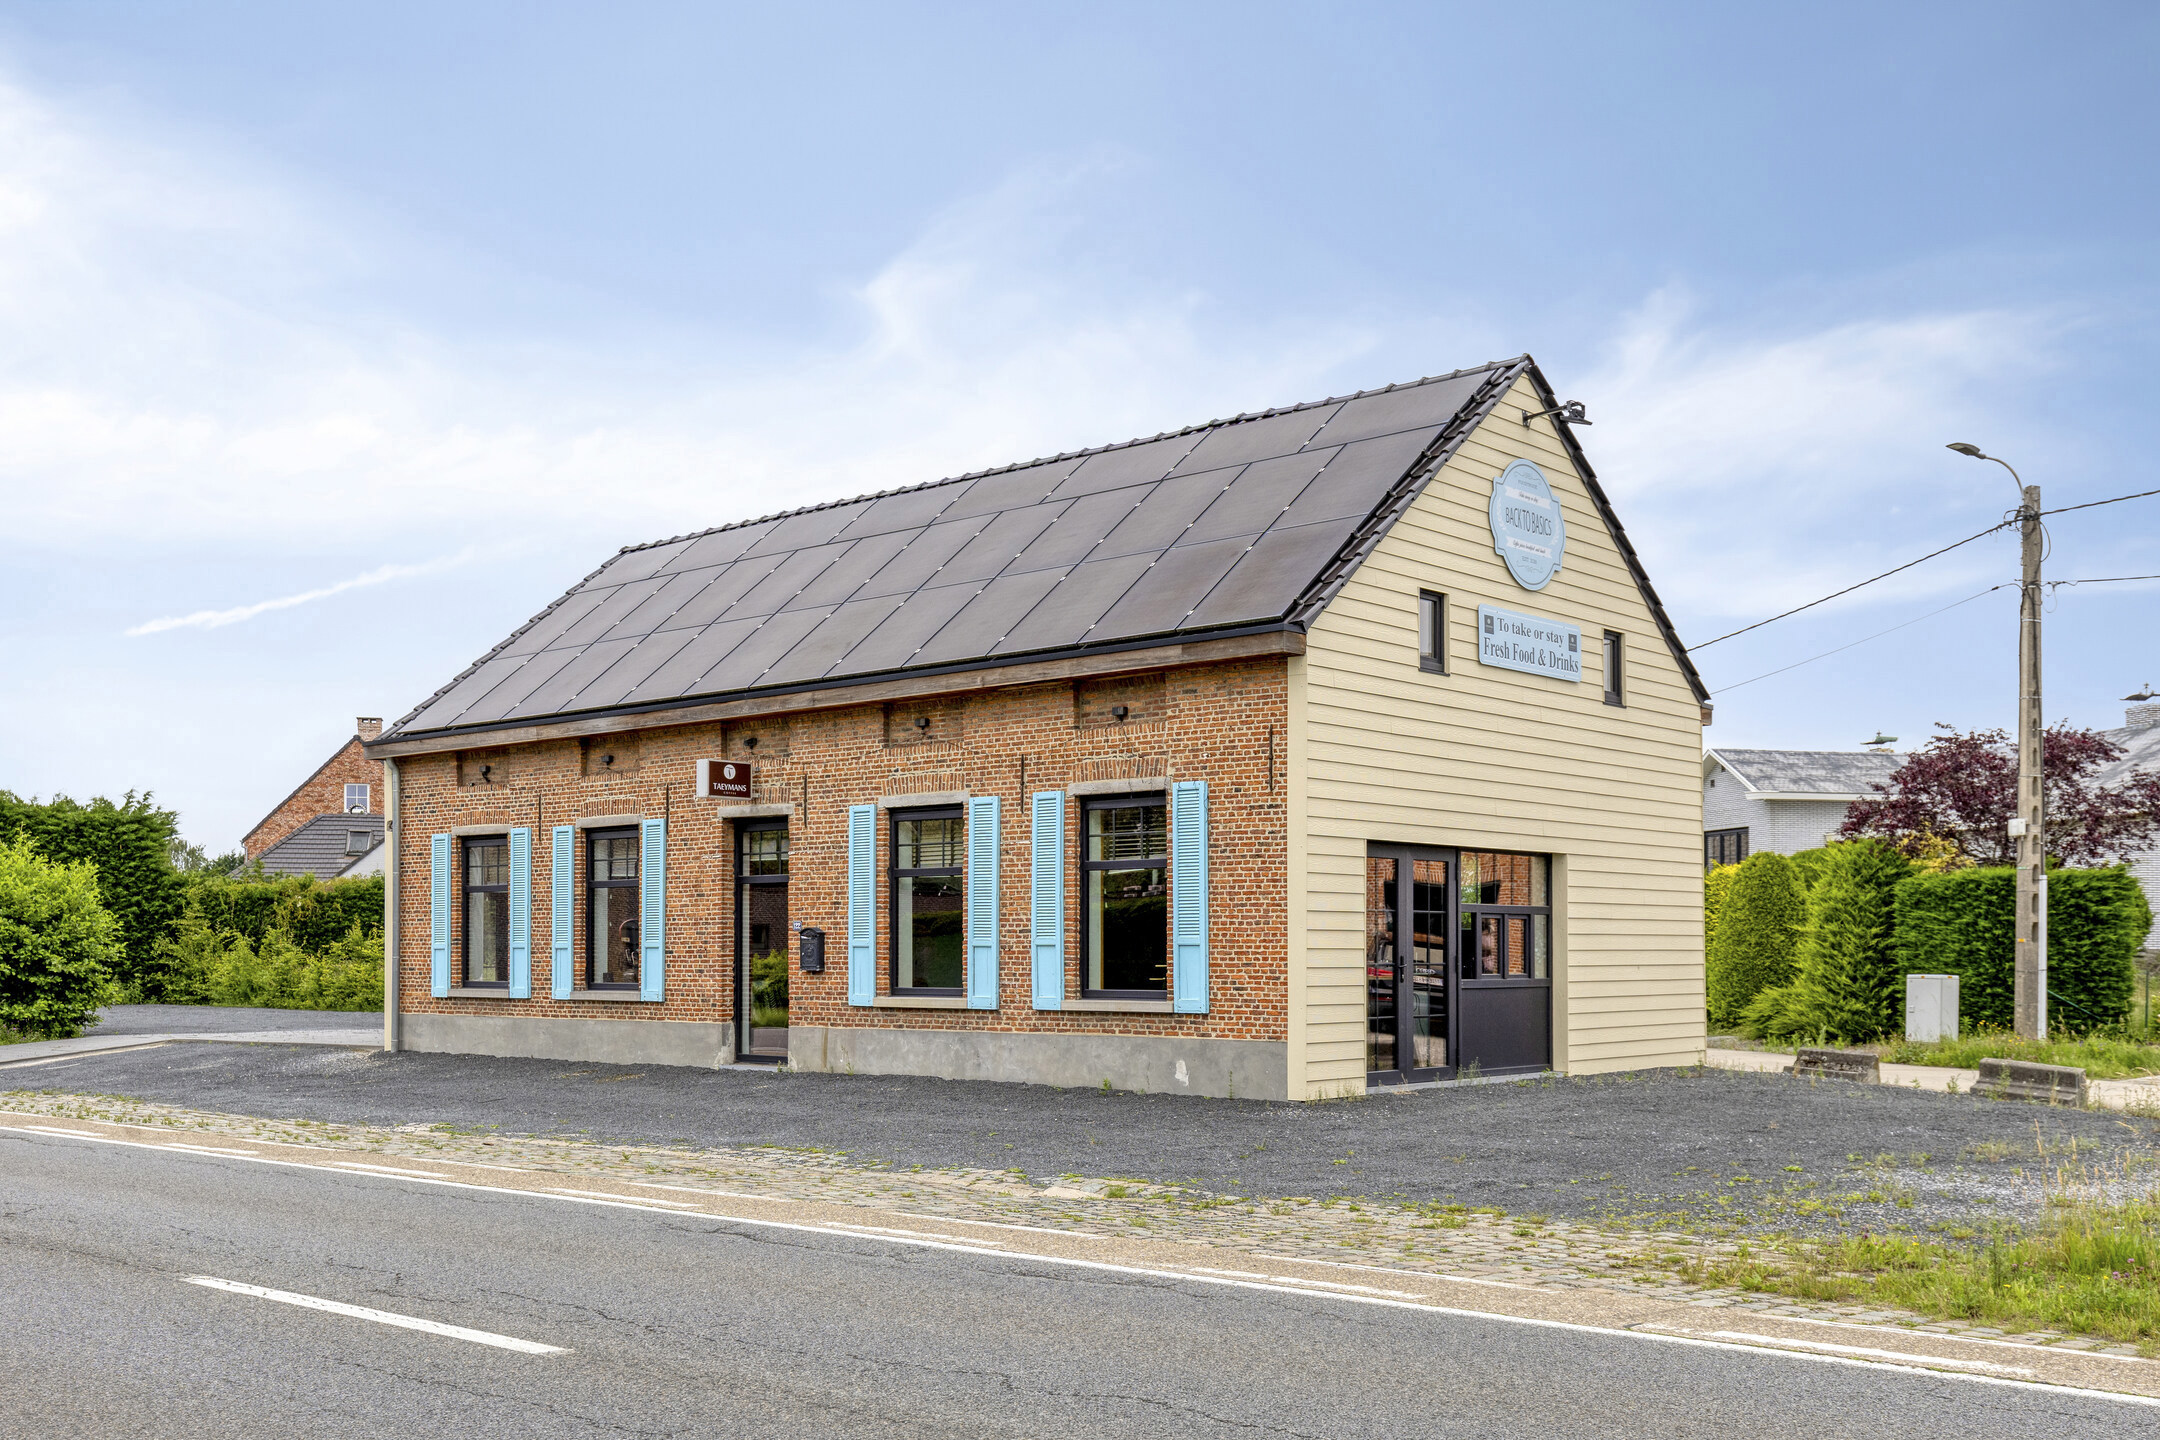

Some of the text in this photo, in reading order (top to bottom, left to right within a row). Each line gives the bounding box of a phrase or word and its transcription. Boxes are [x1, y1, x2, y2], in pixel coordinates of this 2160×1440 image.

[1505, 507, 1552, 537] BACK TO BASICS
[1497, 617, 1509, 633] To
[1511, 622, 1532, 638] take
[1533, 629, 1544, 640] or
[1546, 631, 1564, 648] stay
[1483, 636, 1579, 674] Fresh Food & Drinks
[713, 782, 747, 792] TAEYMANS
